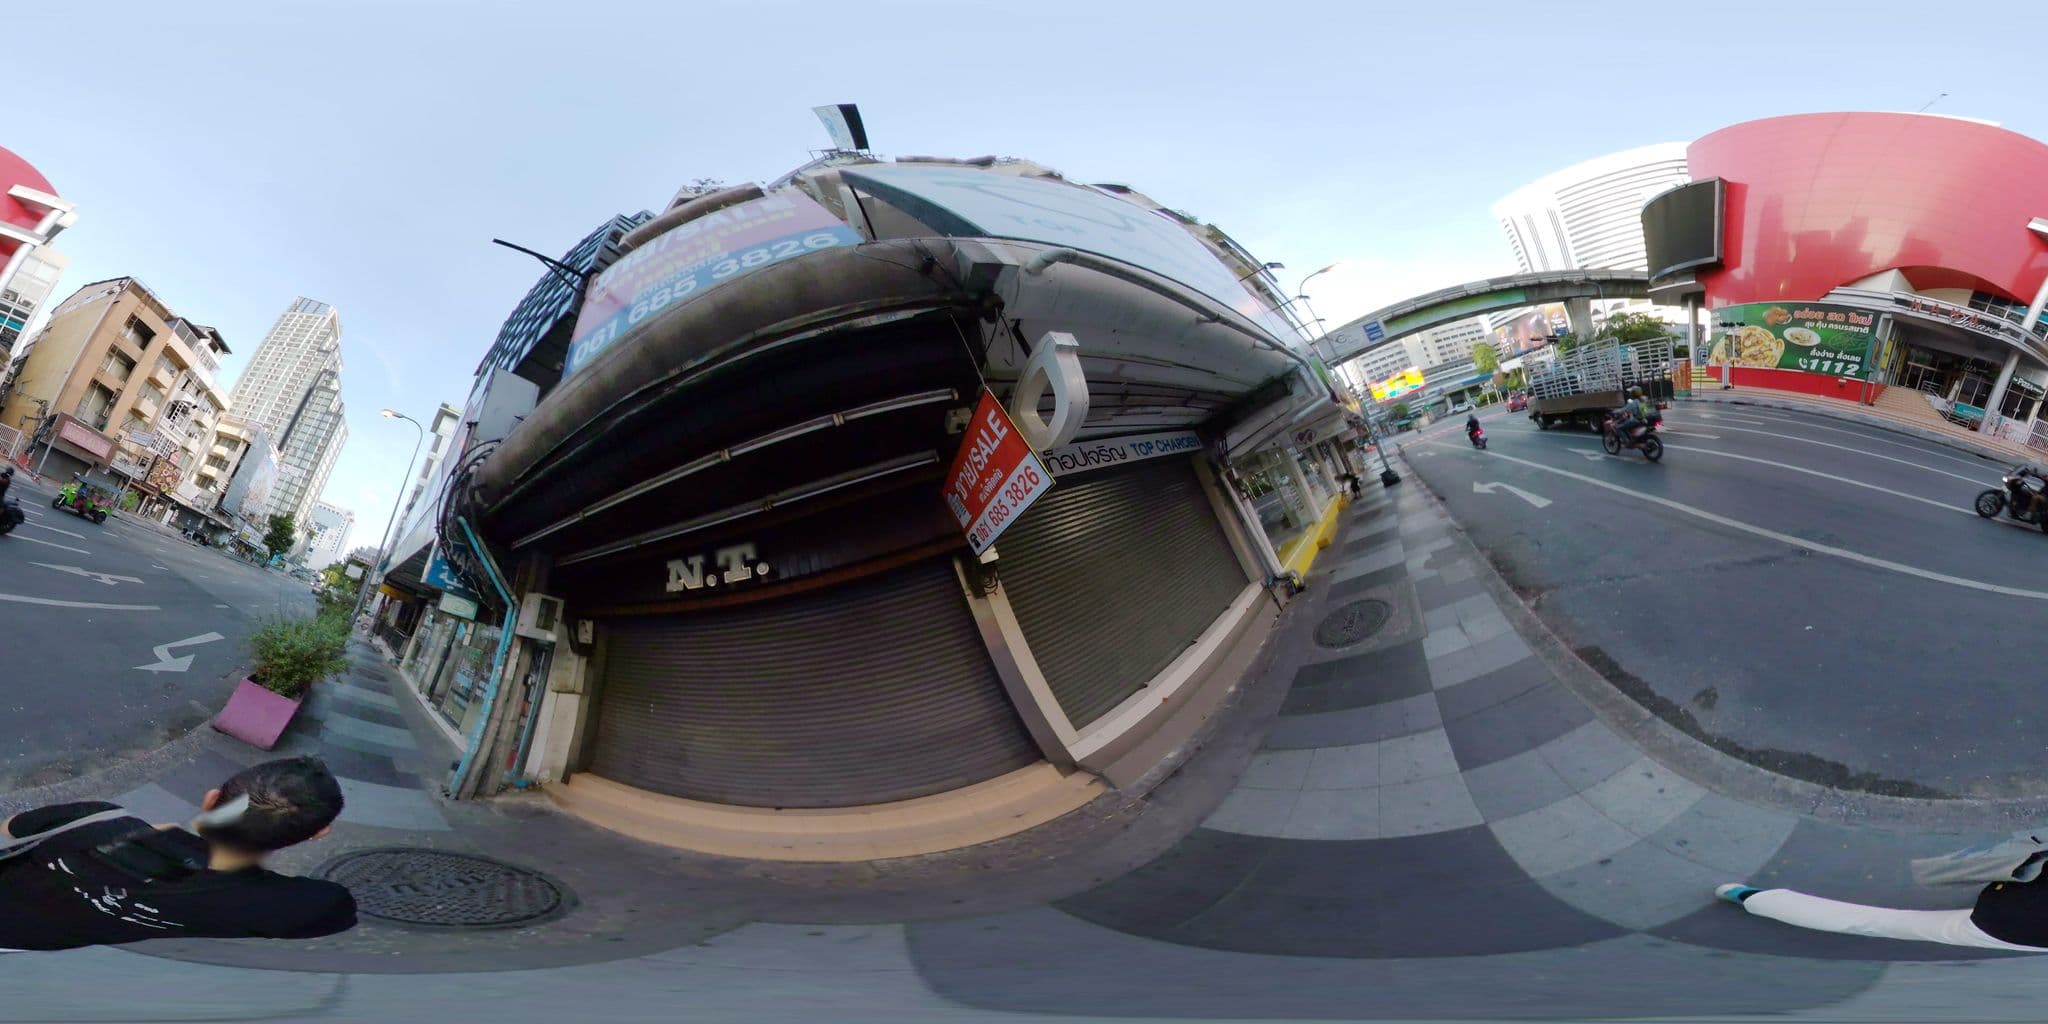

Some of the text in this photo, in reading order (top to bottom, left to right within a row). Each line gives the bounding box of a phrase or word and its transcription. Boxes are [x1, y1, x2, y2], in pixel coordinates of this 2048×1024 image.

[573, 325, 617, 366] 061
[628, 275, 697, 325] 685
[711, 232, 840, 280] 3826
[1809, 358, 1860, 376] 1112
[955, 409, 1008, 500] ขาย/SALE
[1130, 442, 1153, 457] TOP
[975, 465, 1040, 542] 061 685 3826
[665, 543, 770, 592] N.T.
